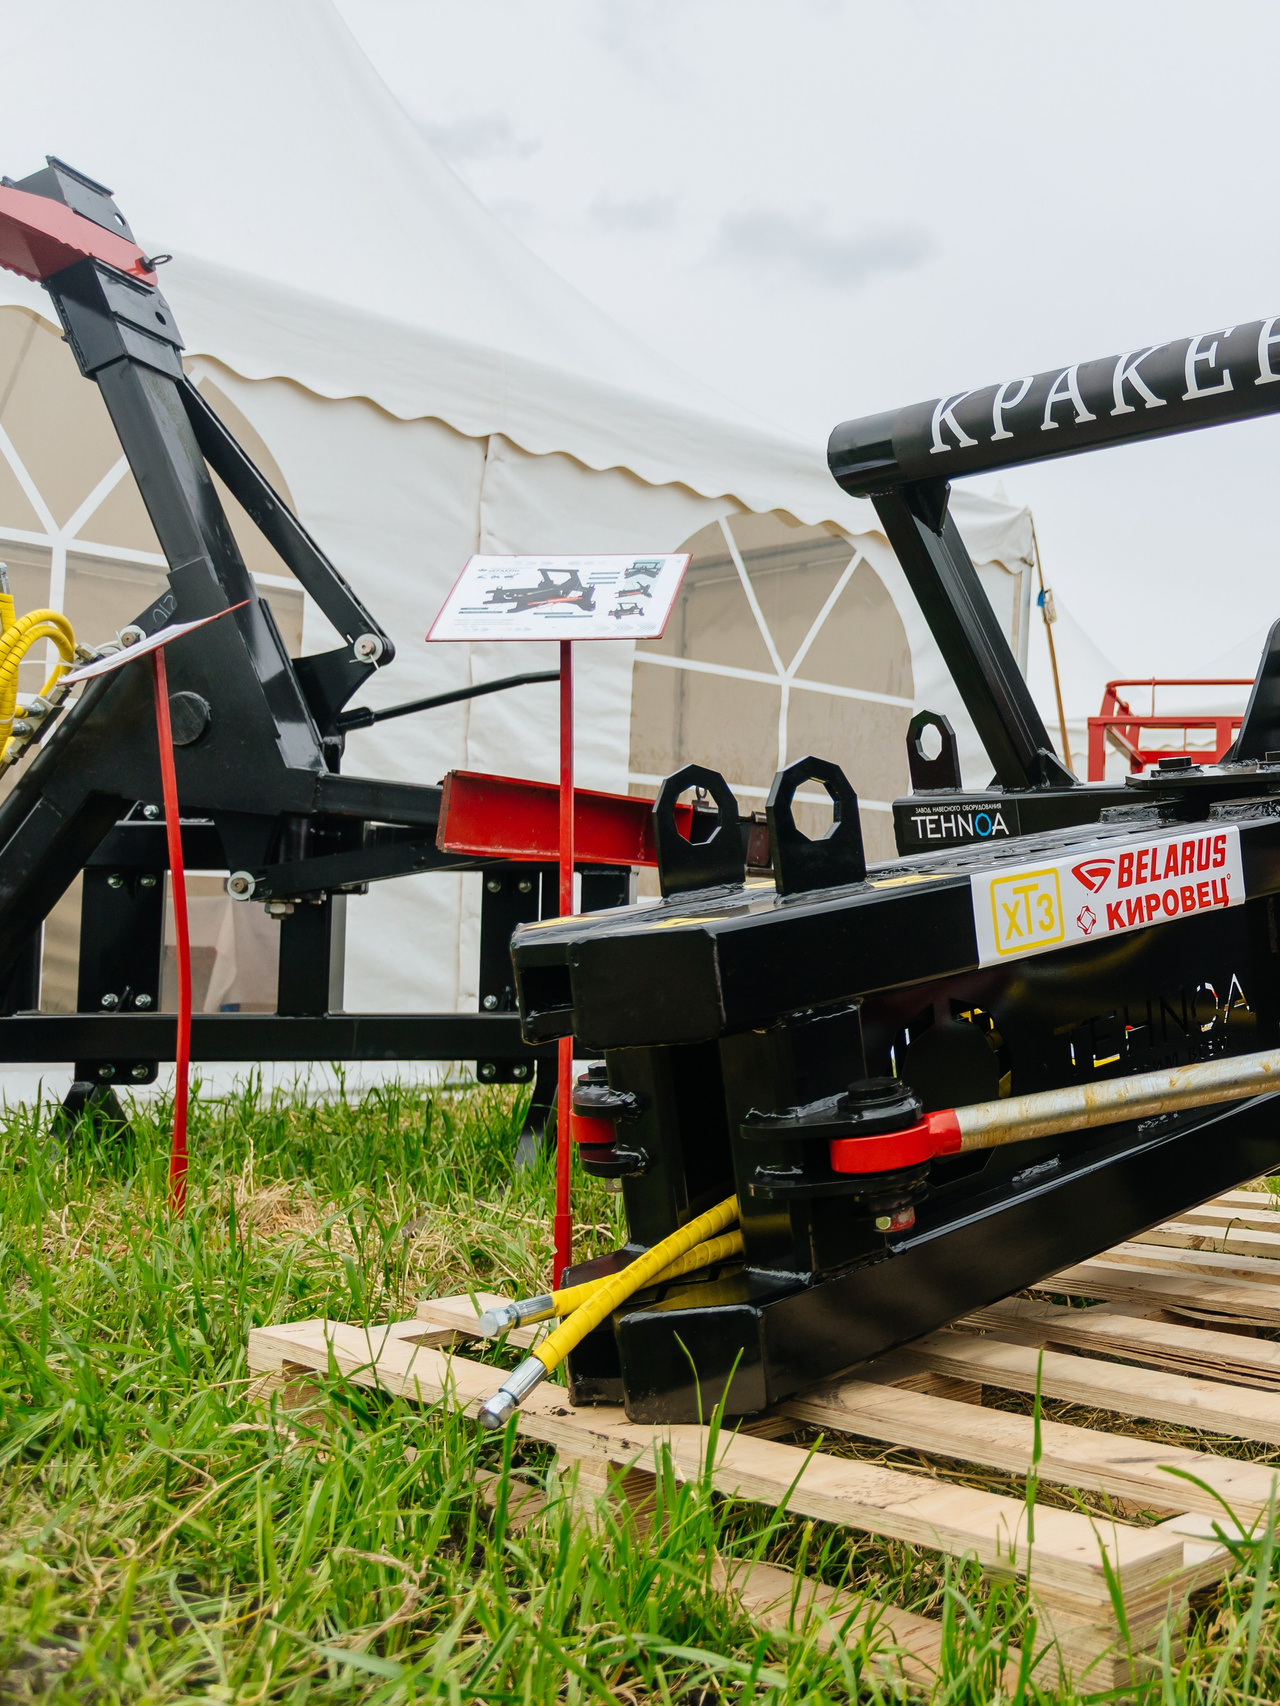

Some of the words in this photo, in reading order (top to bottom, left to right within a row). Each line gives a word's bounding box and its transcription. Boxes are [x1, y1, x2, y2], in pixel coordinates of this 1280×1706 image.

[932, 805, 961, 813] НАВЕСНОГО
[962, 803, 1002, 811] ОБОРУДОВАНИЯ
[1117, 834, 1227, 889] BELARUS
[1106, 877, 1230, 931] КИРОВЕЦ
